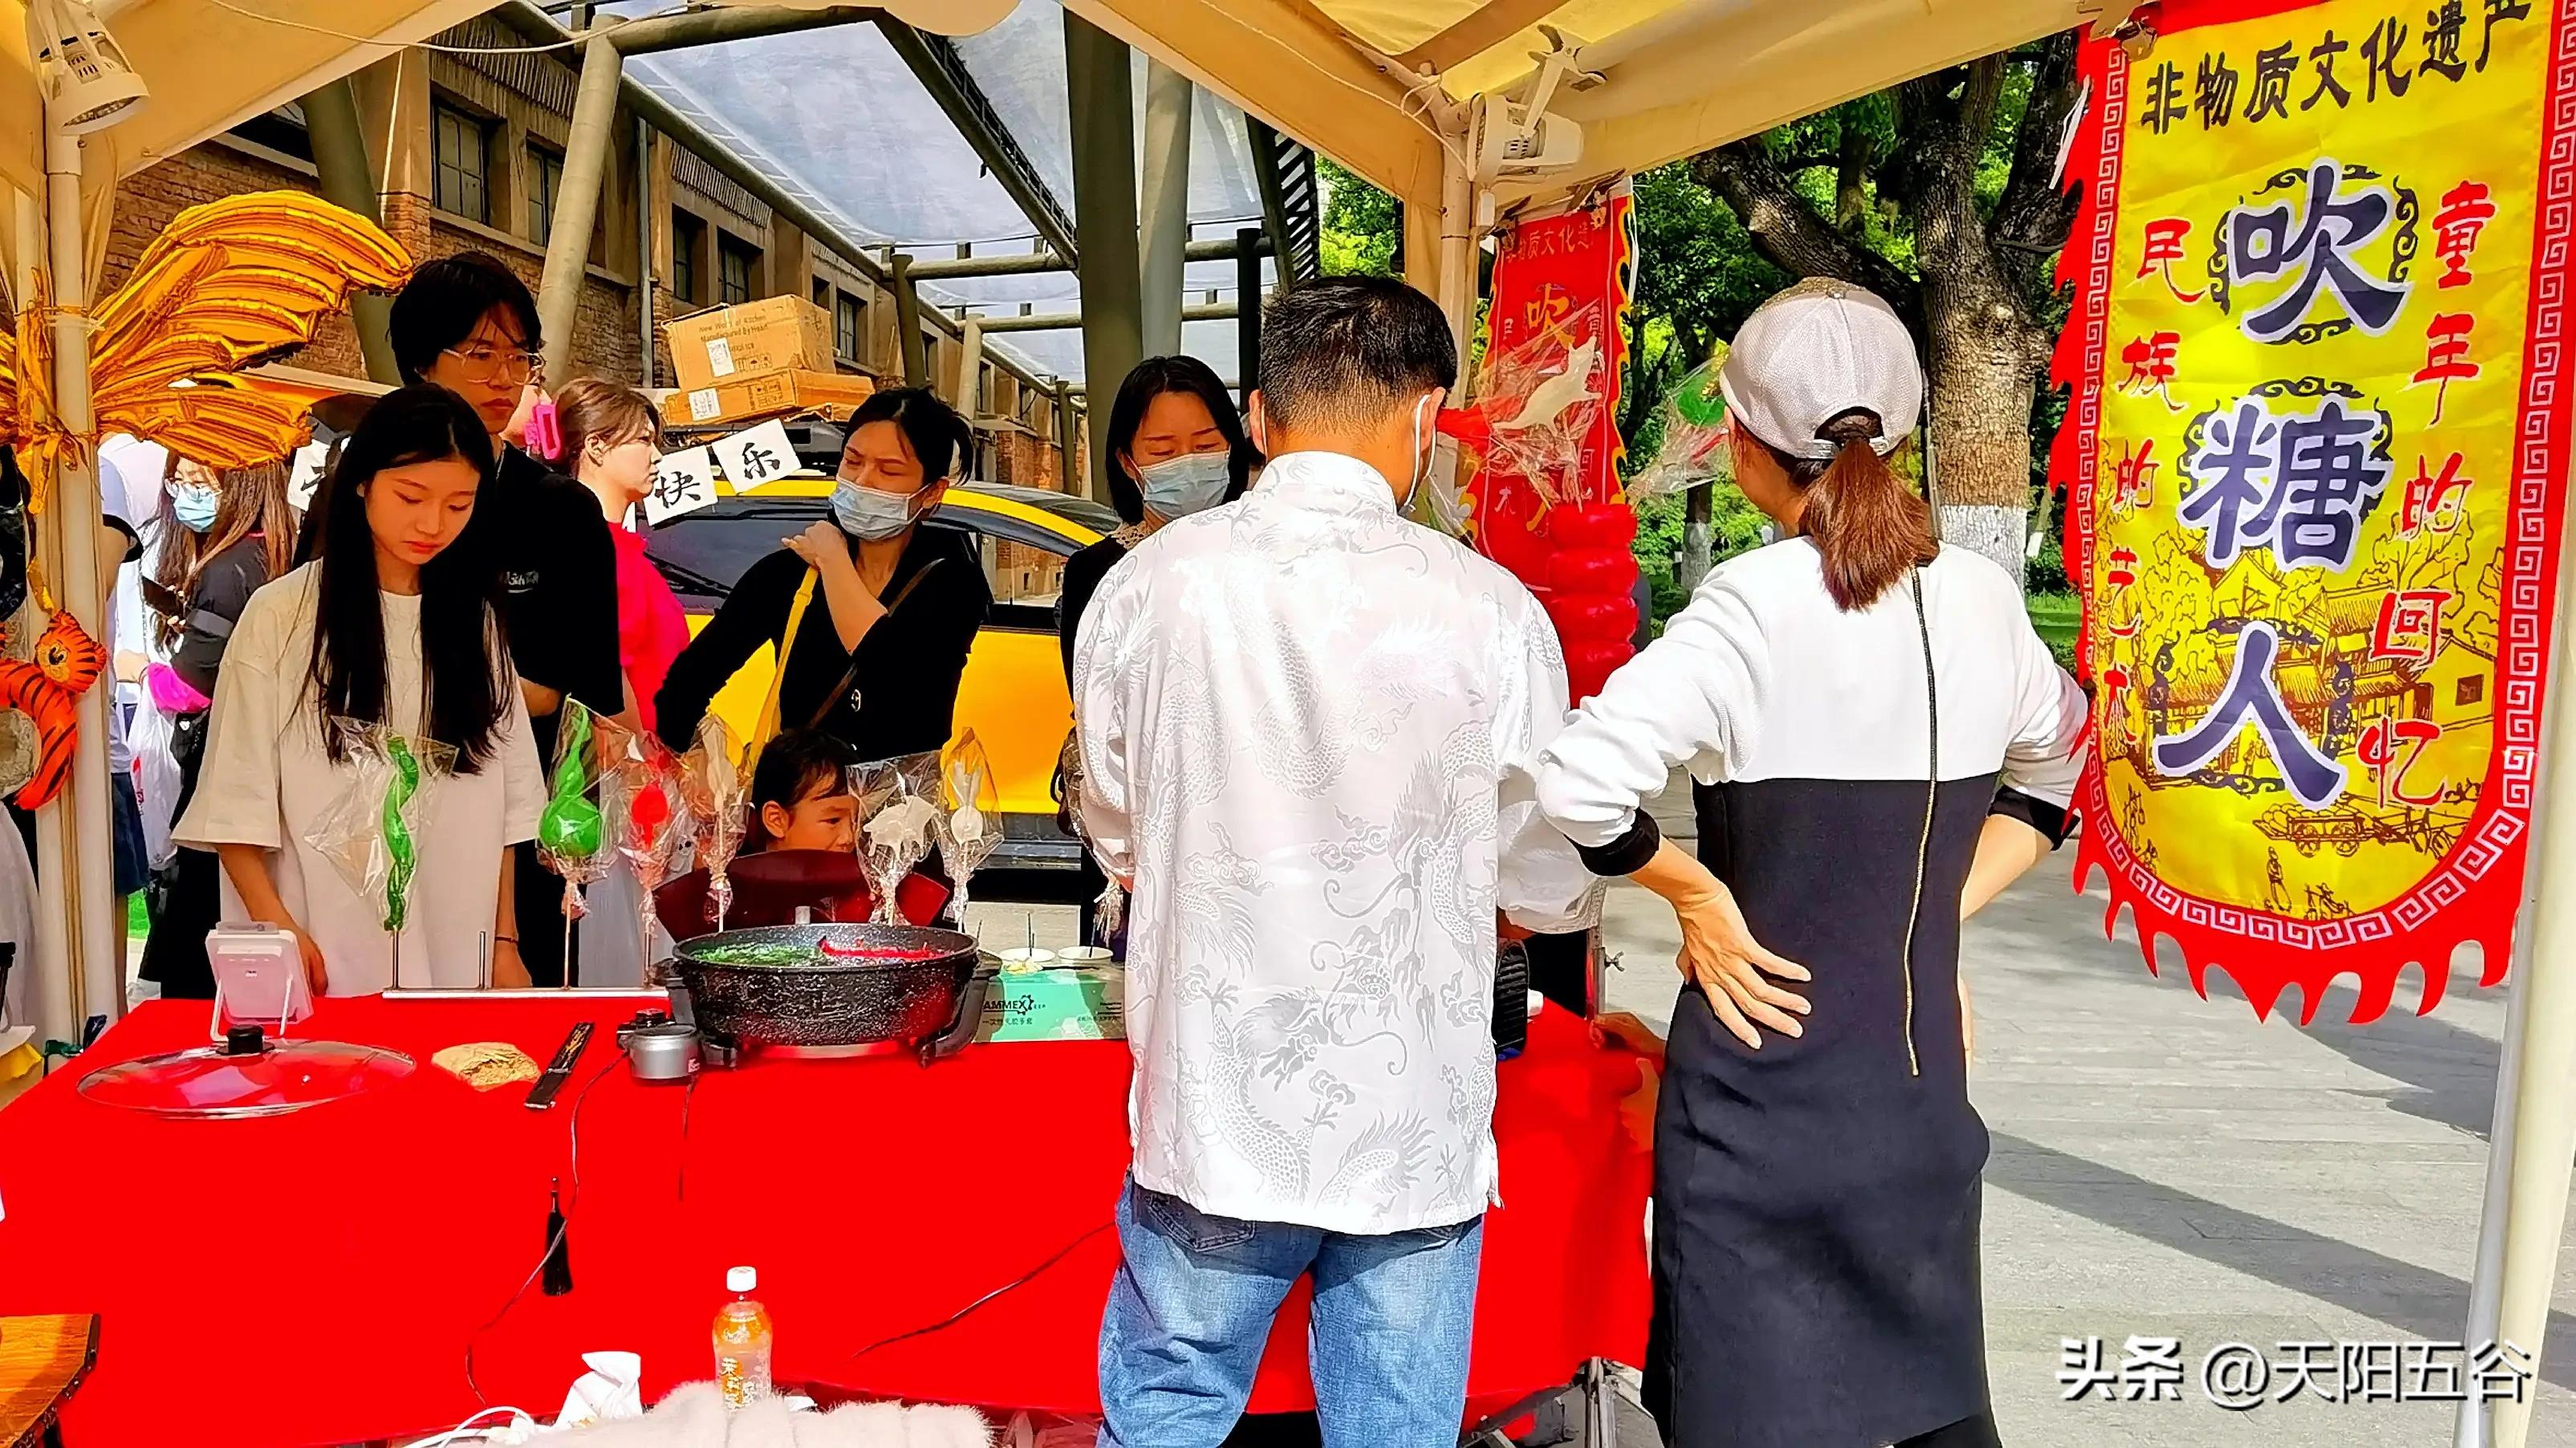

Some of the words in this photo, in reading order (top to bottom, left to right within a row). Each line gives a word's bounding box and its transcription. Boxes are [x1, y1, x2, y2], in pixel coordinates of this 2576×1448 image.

[2140, 0, 2532, 134] 非物质文化遗产
[2103, 218, 2207, 743] 民族的艺术
[2154, 159, 2411, 808] 吹糖人
[2357, 181, 2497, 807] 童年的回忆
[983, 999, 1028, 1011] AMMEX
